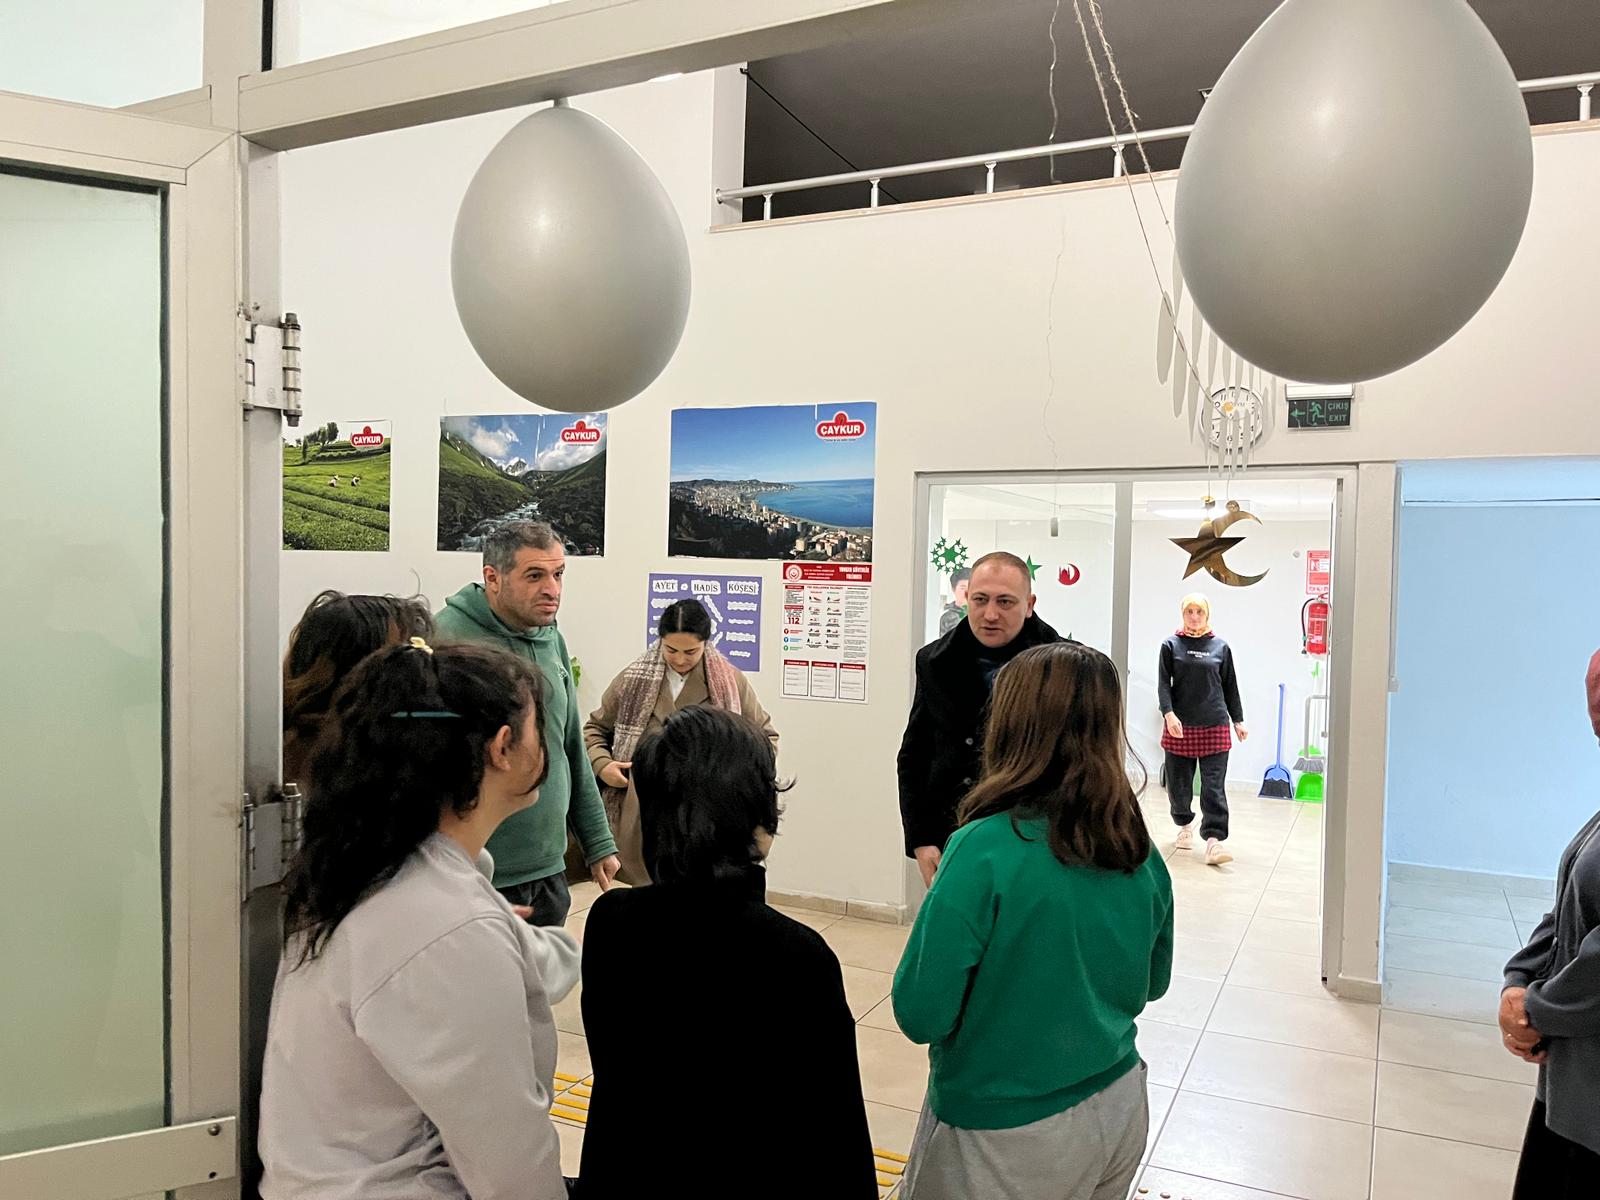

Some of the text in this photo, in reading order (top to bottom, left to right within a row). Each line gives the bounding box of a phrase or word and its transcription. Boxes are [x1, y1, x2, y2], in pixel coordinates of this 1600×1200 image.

[1327, 402, 1349, 411] ÇIKIŞ
[1328, 414, 1347, 422] EXIT
[820, 425, 861, 436] ÇAYKUR
[353, 436, 381, 445] ÇAYKUR
[564, 431, 597, 441] ÇAYKUR
[654, 581, 676, 590] AYET
[693, 583, 718, 592] HADİS
[728, 582, 756, 593] KÖŞESİ
[788, 617, 800, 625] 112
